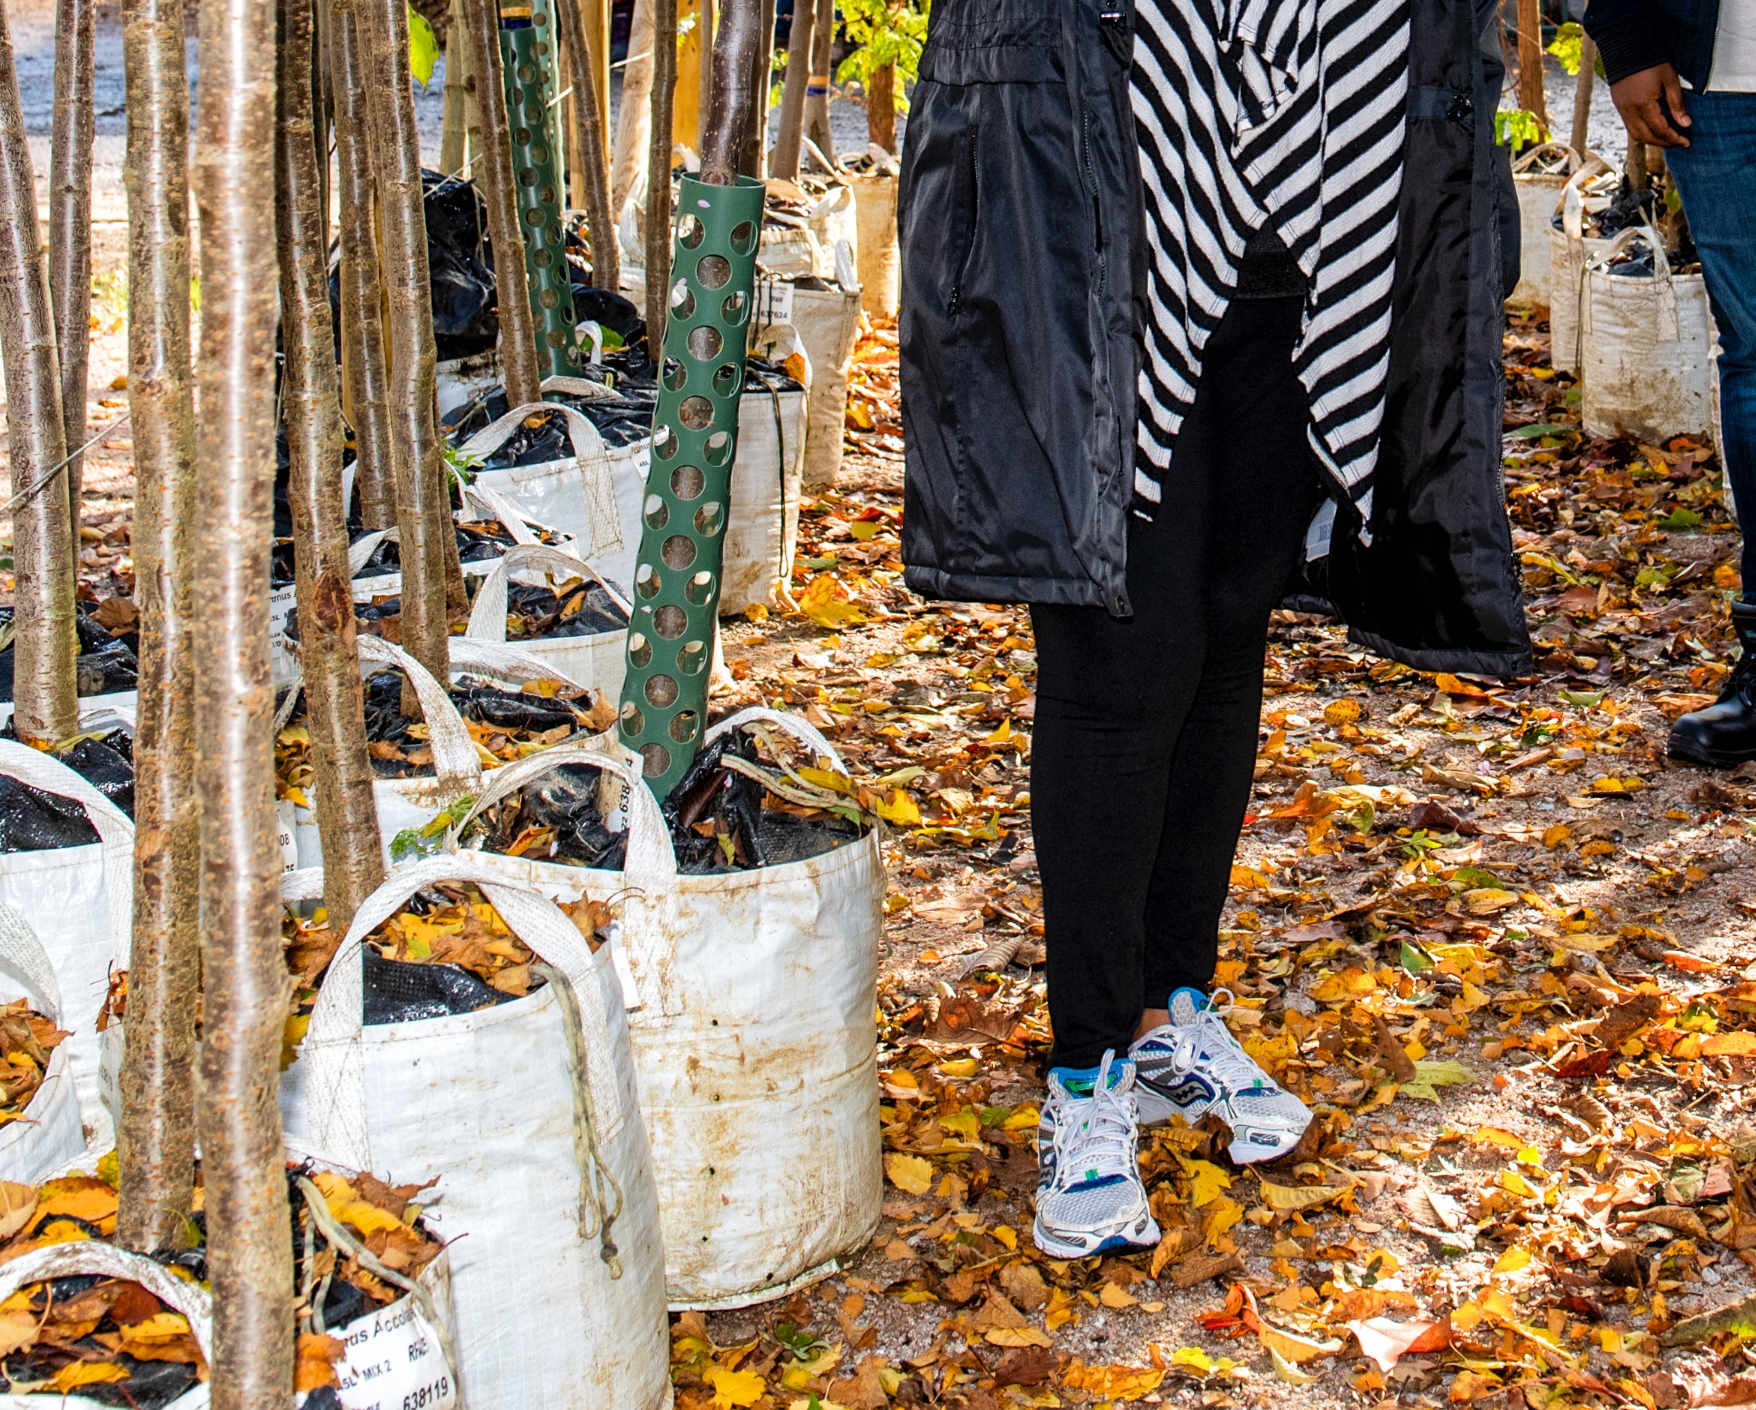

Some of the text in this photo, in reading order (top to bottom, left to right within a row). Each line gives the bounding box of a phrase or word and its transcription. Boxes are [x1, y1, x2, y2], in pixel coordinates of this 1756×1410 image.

[362, 1364, 384, 1382] MIX
[384, 1360, 392, 1373] 2
[403, 1376, 449, 1410] 638119
